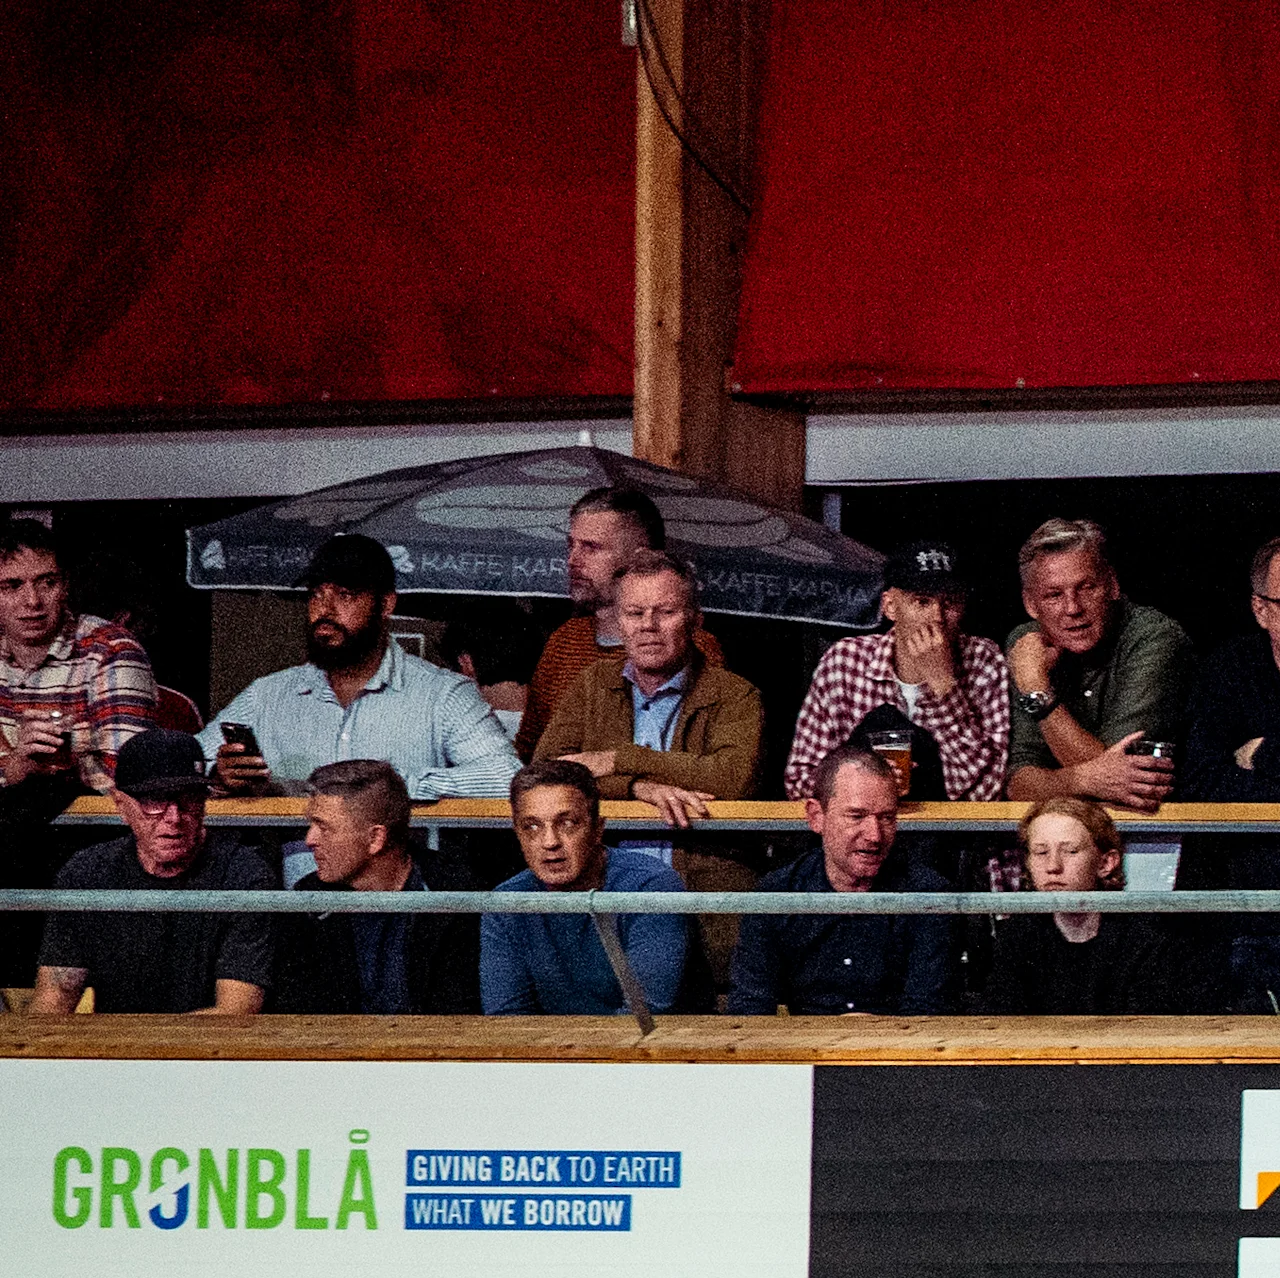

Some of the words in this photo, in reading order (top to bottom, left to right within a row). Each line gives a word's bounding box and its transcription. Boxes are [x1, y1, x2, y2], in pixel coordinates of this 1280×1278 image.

[412, 1154, 493, 1182] GIVING
[500, 1155, 562, 1182] BACK
[567, 1156, 597, 1182] TO
[603, 1156, 675, 1183] EARTH
[412, 1198, 475, 1225] WHAT
[480, 1199, 517, 1225] WE
[524, 1200, 625, 1226] BORROW
